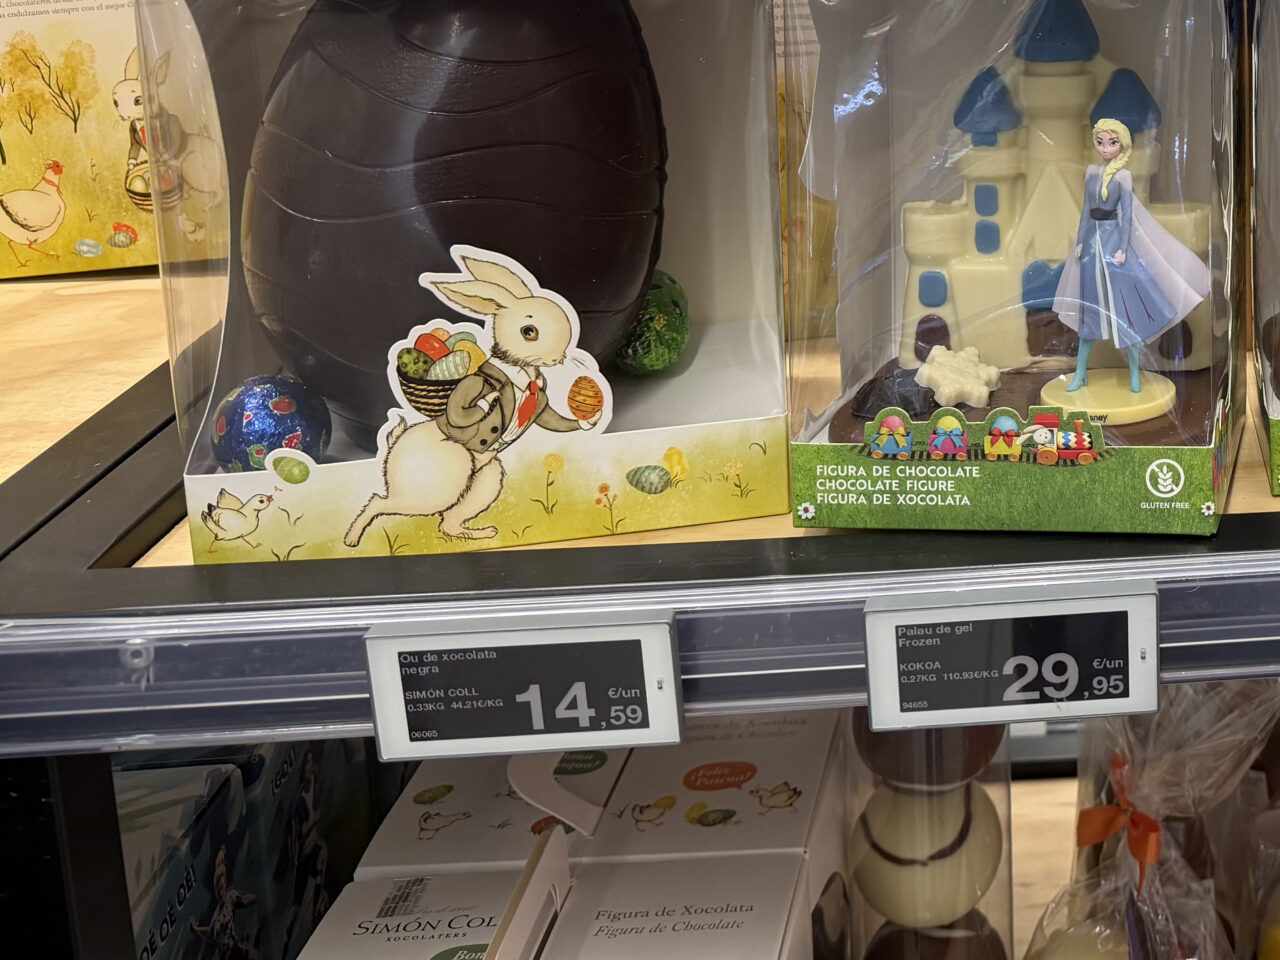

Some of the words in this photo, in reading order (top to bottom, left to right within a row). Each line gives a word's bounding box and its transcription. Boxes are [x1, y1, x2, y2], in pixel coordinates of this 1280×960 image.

[816, 465, 867, 477] FIGURA
[872, 465, 891, 477] DE
[896, 466, 980, 478] CHOCOLATE
[816, 479, 900, 491] CHOCOLATE
[906, 479, 955, 491] FIGURE
[816, 493, 867, 505] FIGURA
[873, 494, 892, 505] DE
[896, 494, 970, 506] XOCOLATA
[1140, 501, 1169, 509] GLUTEN
[898, 625, 933, 636] Palau
[936, 625, 951, 634] de
[955, 623, 973, 634] gel
[898, 637, 940, 647] Frozen
[400, 654, 418, 663] Ou
[423, 653, 438, 662] de
[441, 650, 497, 661] xocolata
[900, 661, 941, 671] KOKOA
[1092, 658, 1124, 669] €/un
[402, 665, 439, 676] negra
[901, 674, 936, 683] 0.27KG
[405, 688, 444, 700] SIMÓN
[448, 688, 479, 697] COLL
[608, 688, 640, 698] €/un
[407, 702, 444, 711] 0.33KG
[902, 701, 928, 709] 94655
[594, 909, 649, 922] Figura
[655, 907, 676, 917] de
[681, 903, 754, 916] Xocolata
[353, 917, 443, 936] SIMÓN
[448, 914, 497, 930] COL
[593, 924, 645, 939] Figura
[649, 922, 667, 934] de
[671, 919, 744, 932] Chocolate
[385, 932, 467, 942] XOCOLATERS
